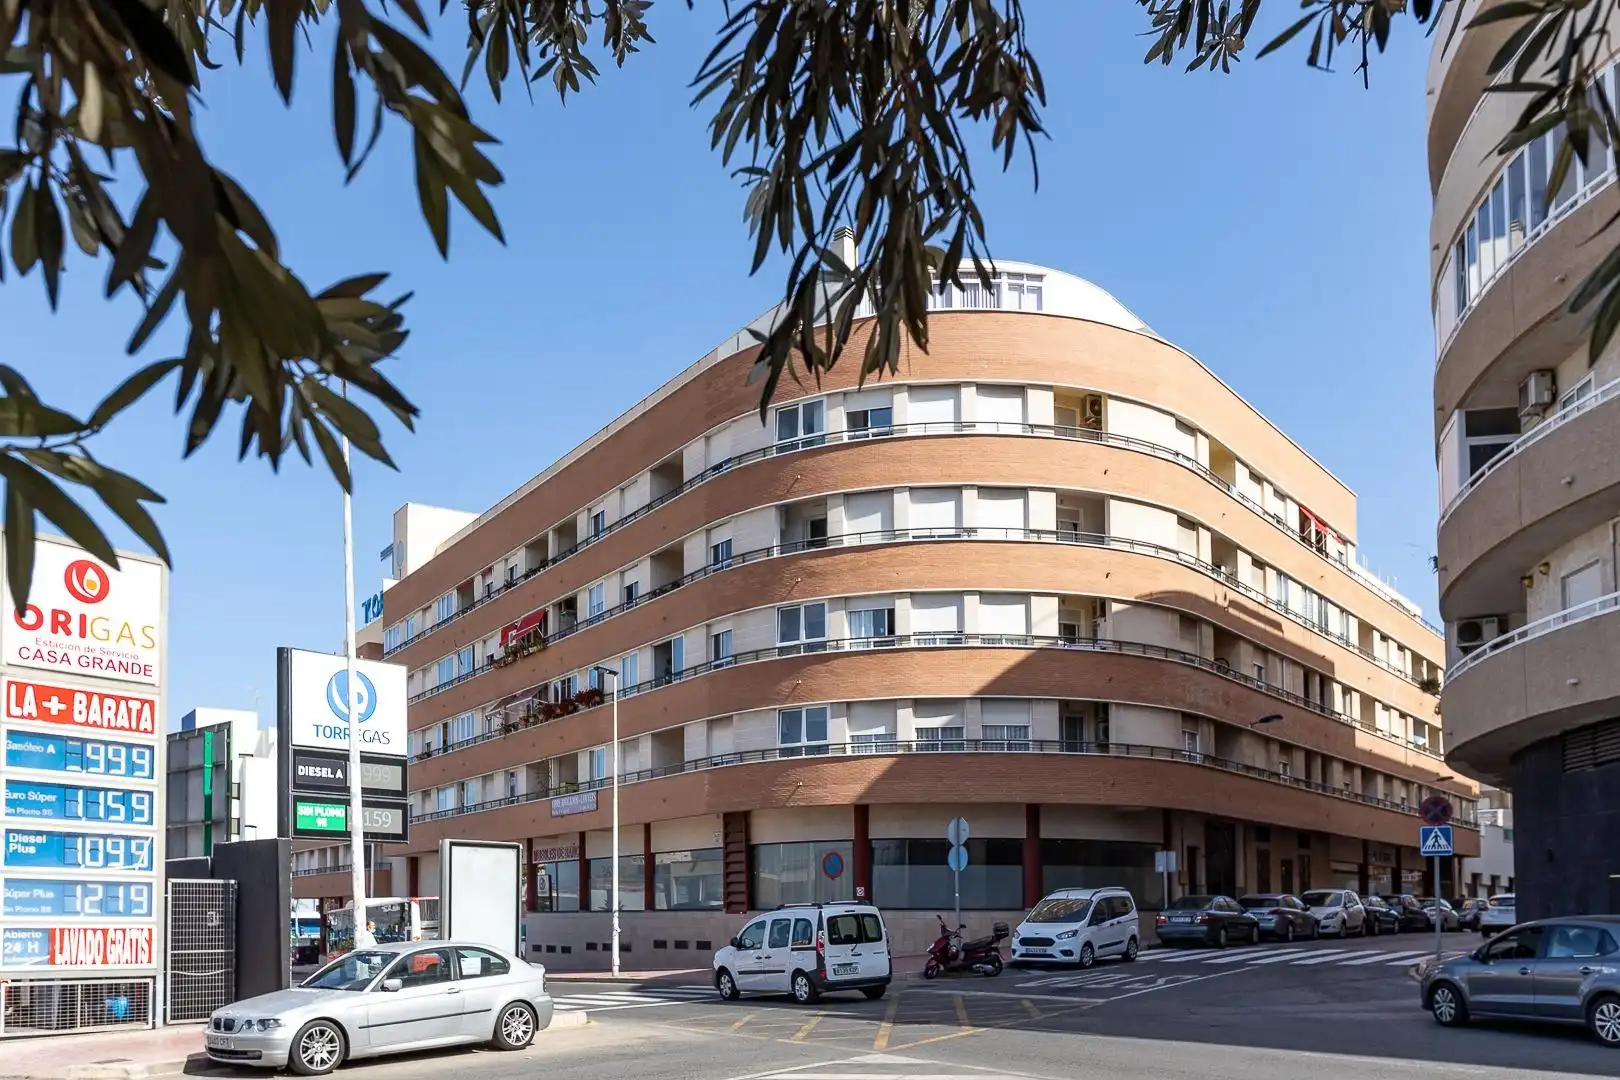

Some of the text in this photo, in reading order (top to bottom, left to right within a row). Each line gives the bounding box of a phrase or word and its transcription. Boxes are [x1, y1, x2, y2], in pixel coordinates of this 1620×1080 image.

[14, 603, 155, 649] ORIGAS
[84, 643, 96, 654] de
[100, 647, 139, 661] Servicio
[18, 646, 153, 677] CASA GRANDE
[9, 683, 38, 718] LA
[73, 692, 152, 732] BARATA
[313, 724, 391, 745] TORRGAS
[46, 744, 56, 755] A
[298, 765, 343, 779] DIESEL A
[9, 833, 47, 844] Diesel
[9, 843, 37, 854] Plus
[33, 888, 55, 899] Plus
[4, 930, 43, 939] Abierto
[4, 941, 39, 954] 24 H
[54, 927, 150, 965] LAVADO GRATIS
